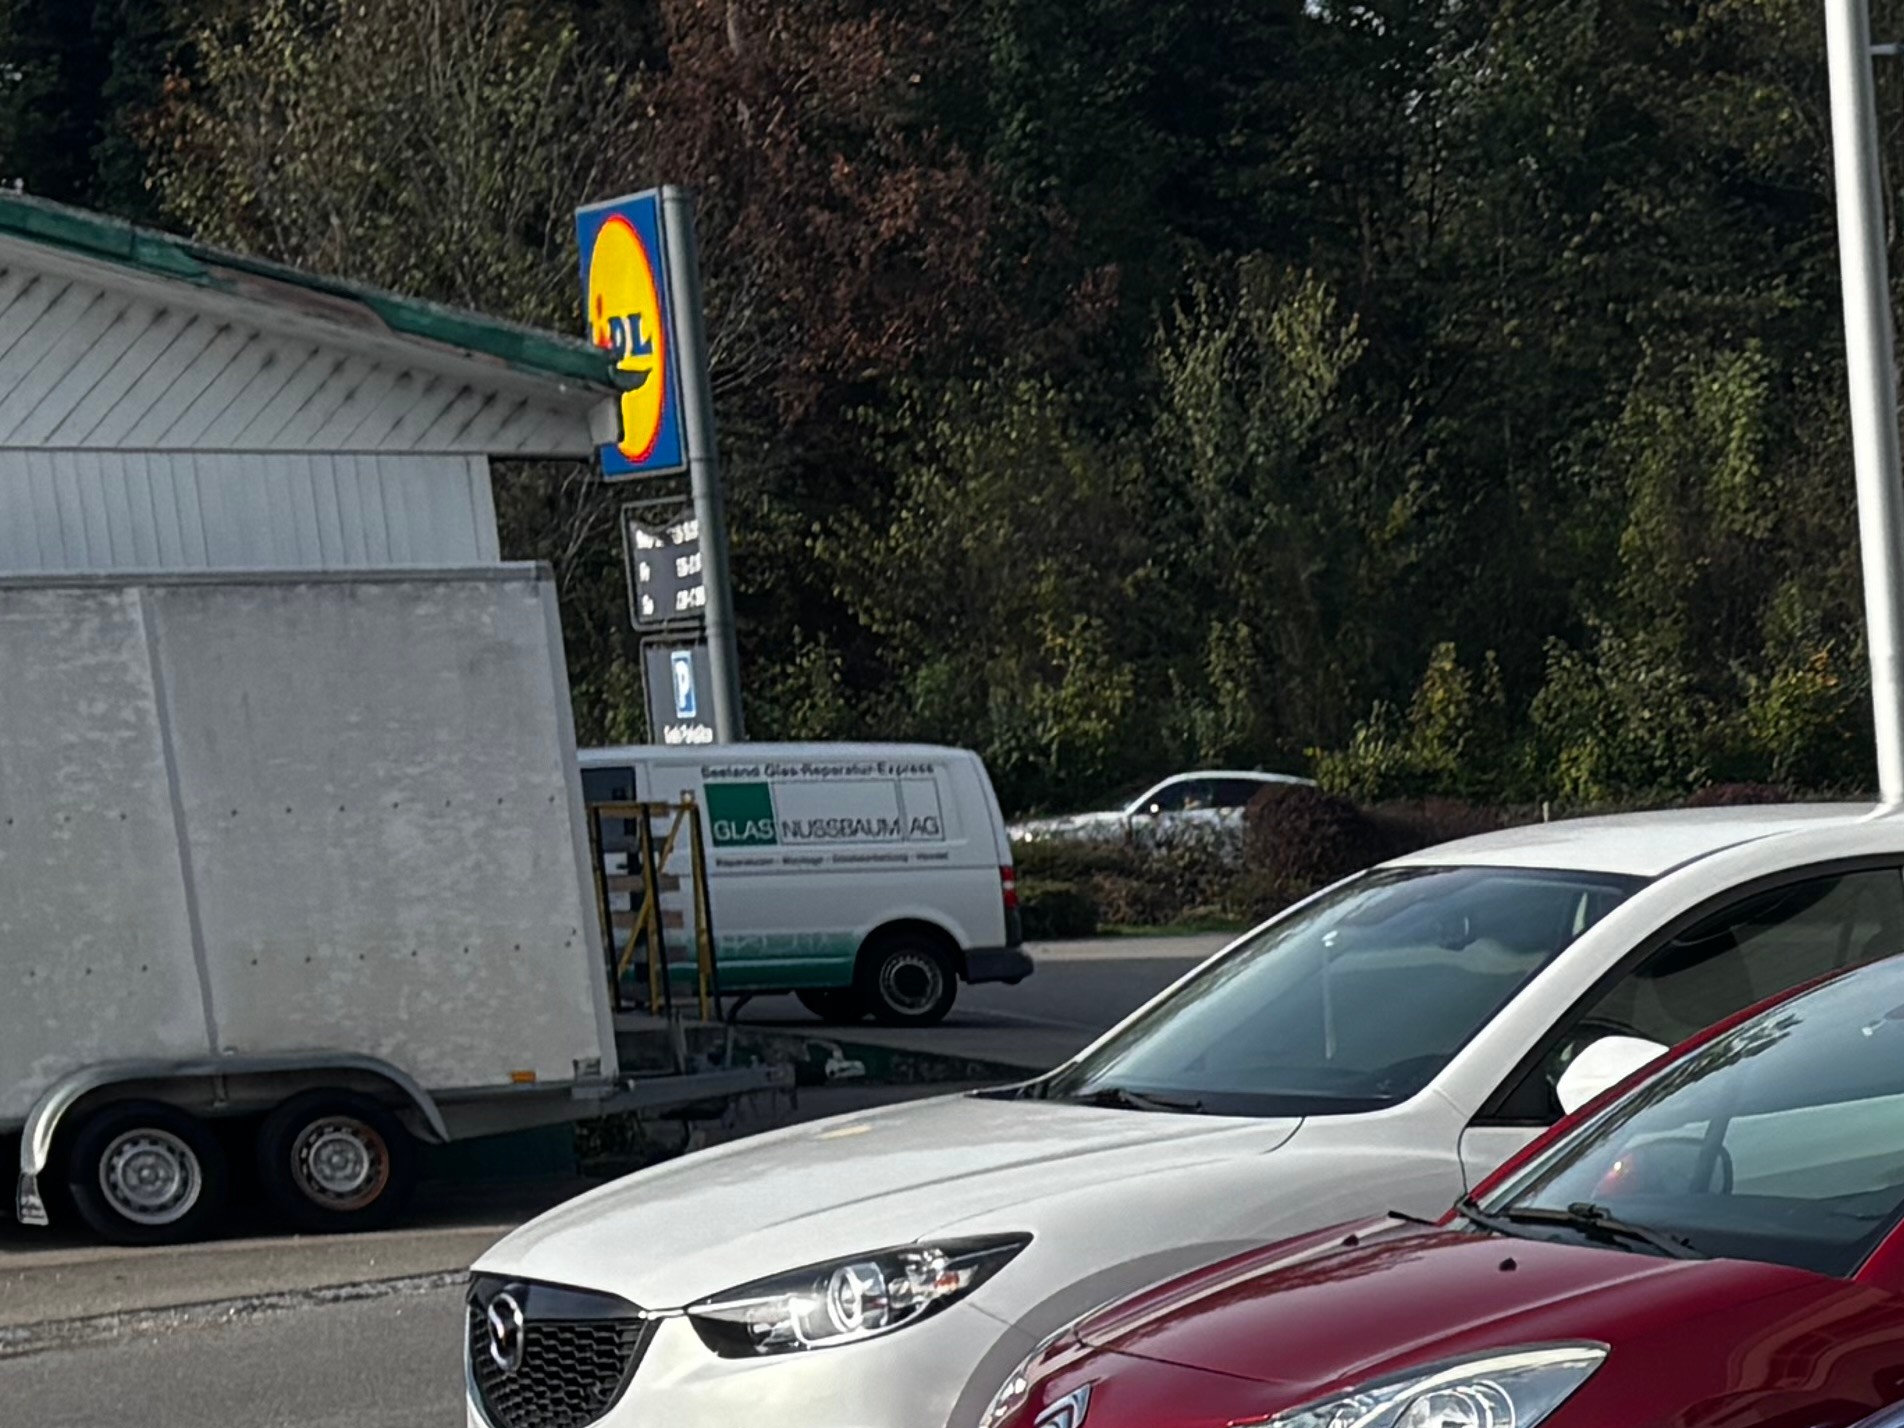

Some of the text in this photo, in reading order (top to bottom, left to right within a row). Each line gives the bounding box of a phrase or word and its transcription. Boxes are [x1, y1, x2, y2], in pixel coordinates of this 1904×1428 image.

[713, 815, 940, 841] GLAS NUSSBAUM AG
